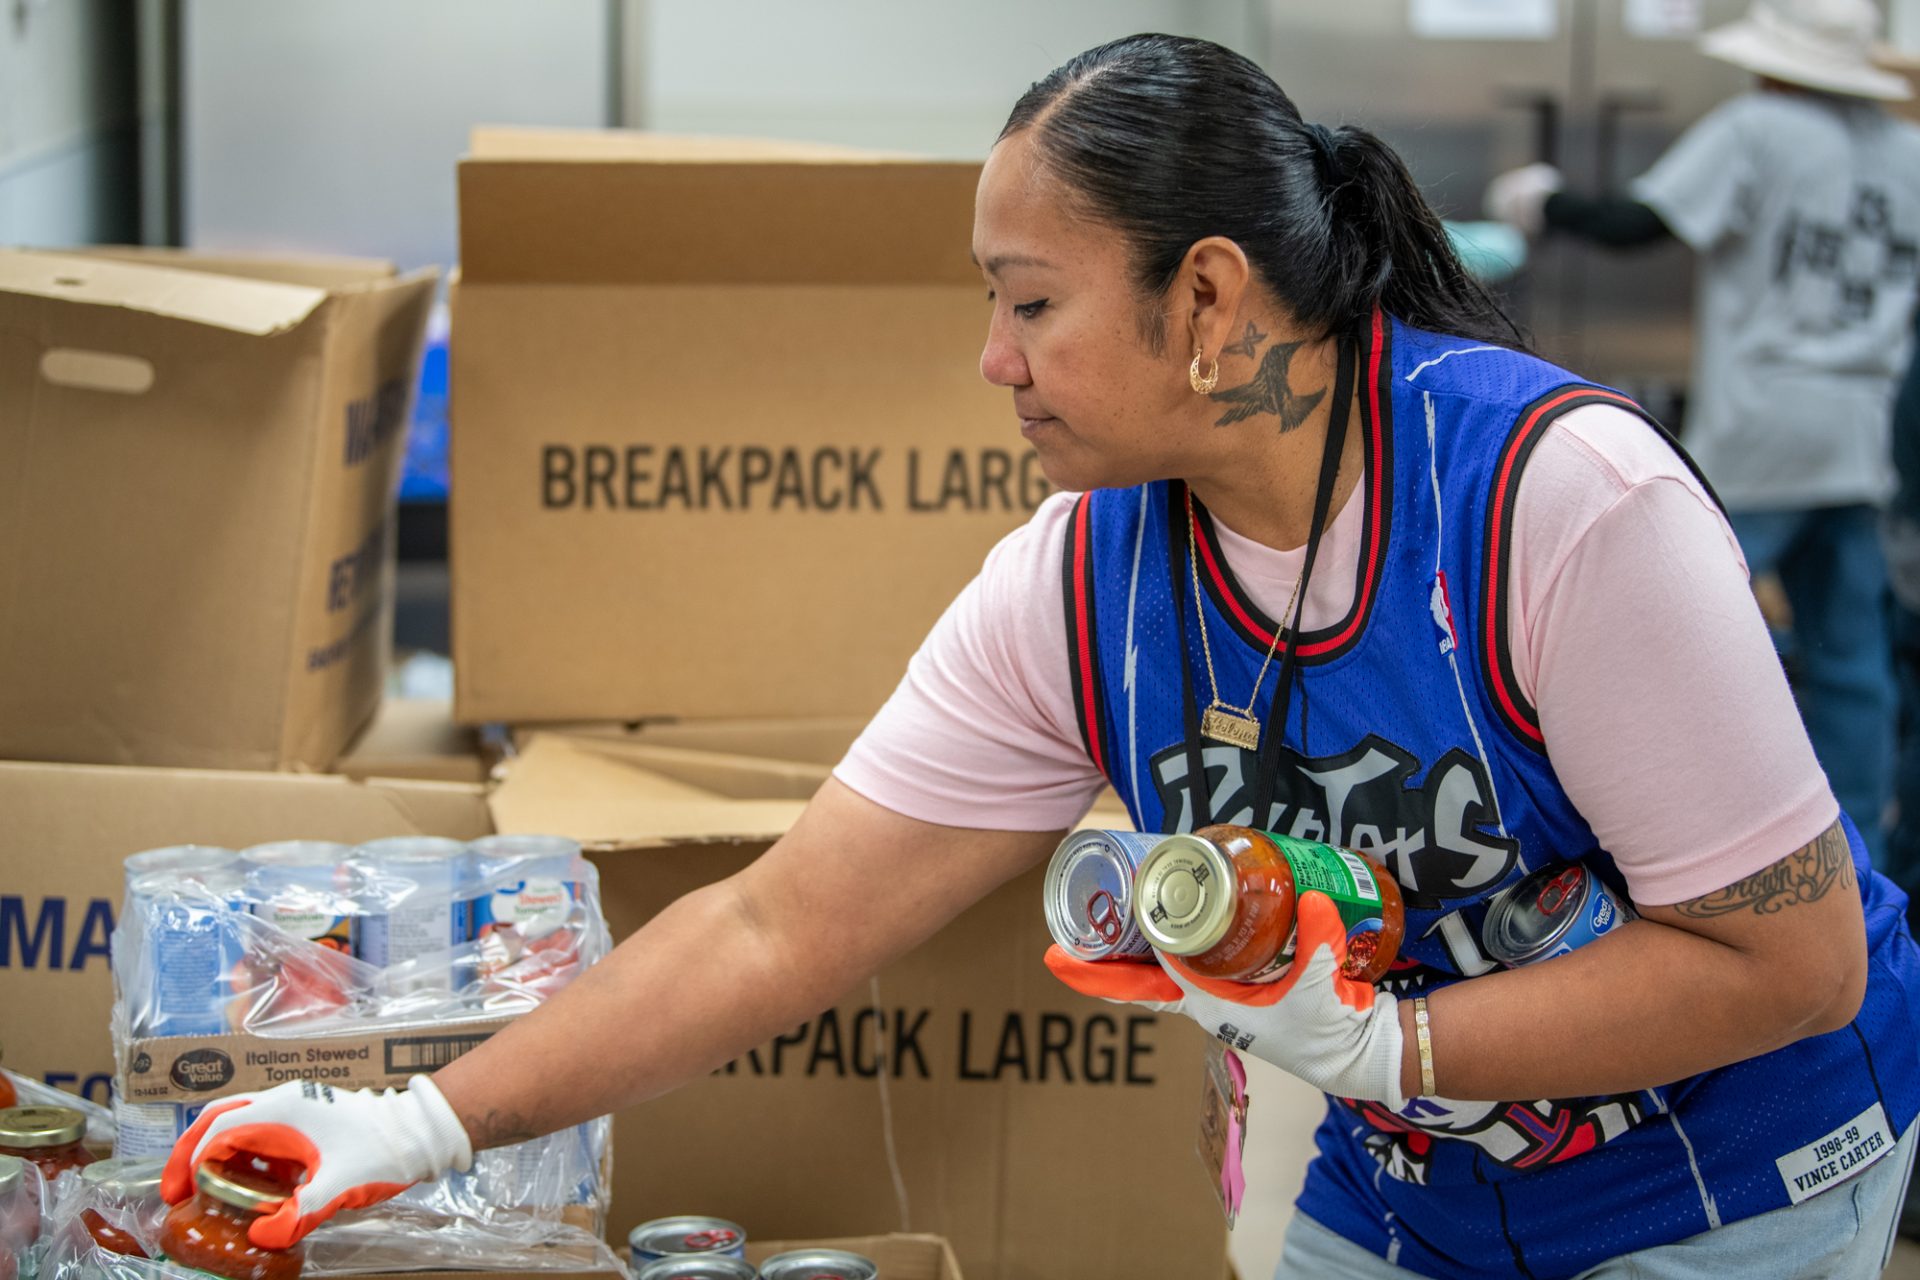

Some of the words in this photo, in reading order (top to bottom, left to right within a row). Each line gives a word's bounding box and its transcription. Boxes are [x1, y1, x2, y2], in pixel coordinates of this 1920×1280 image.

[541, 443, 883, 513] BREAKPACK
[907, 446, 1050, 512] LARG
[1593, 898, 1608, 928] Great
[245, 1050, 301, 1066] Italian
[305, 1046, 370, 1063] Stewed
[959, 1010, 1158, 1085] LARGE
[177, 1059, 223, 1075] Great
[189, 1072, 224, 1084] Value
[265, 1065, 350, 1082] Tomatoes
[1813, 1126, 1860, 1162] 1998-99
[1794, 1161, 1839, 1192] VINCE
[1839, 1131, 1885, 1171] CARTER
